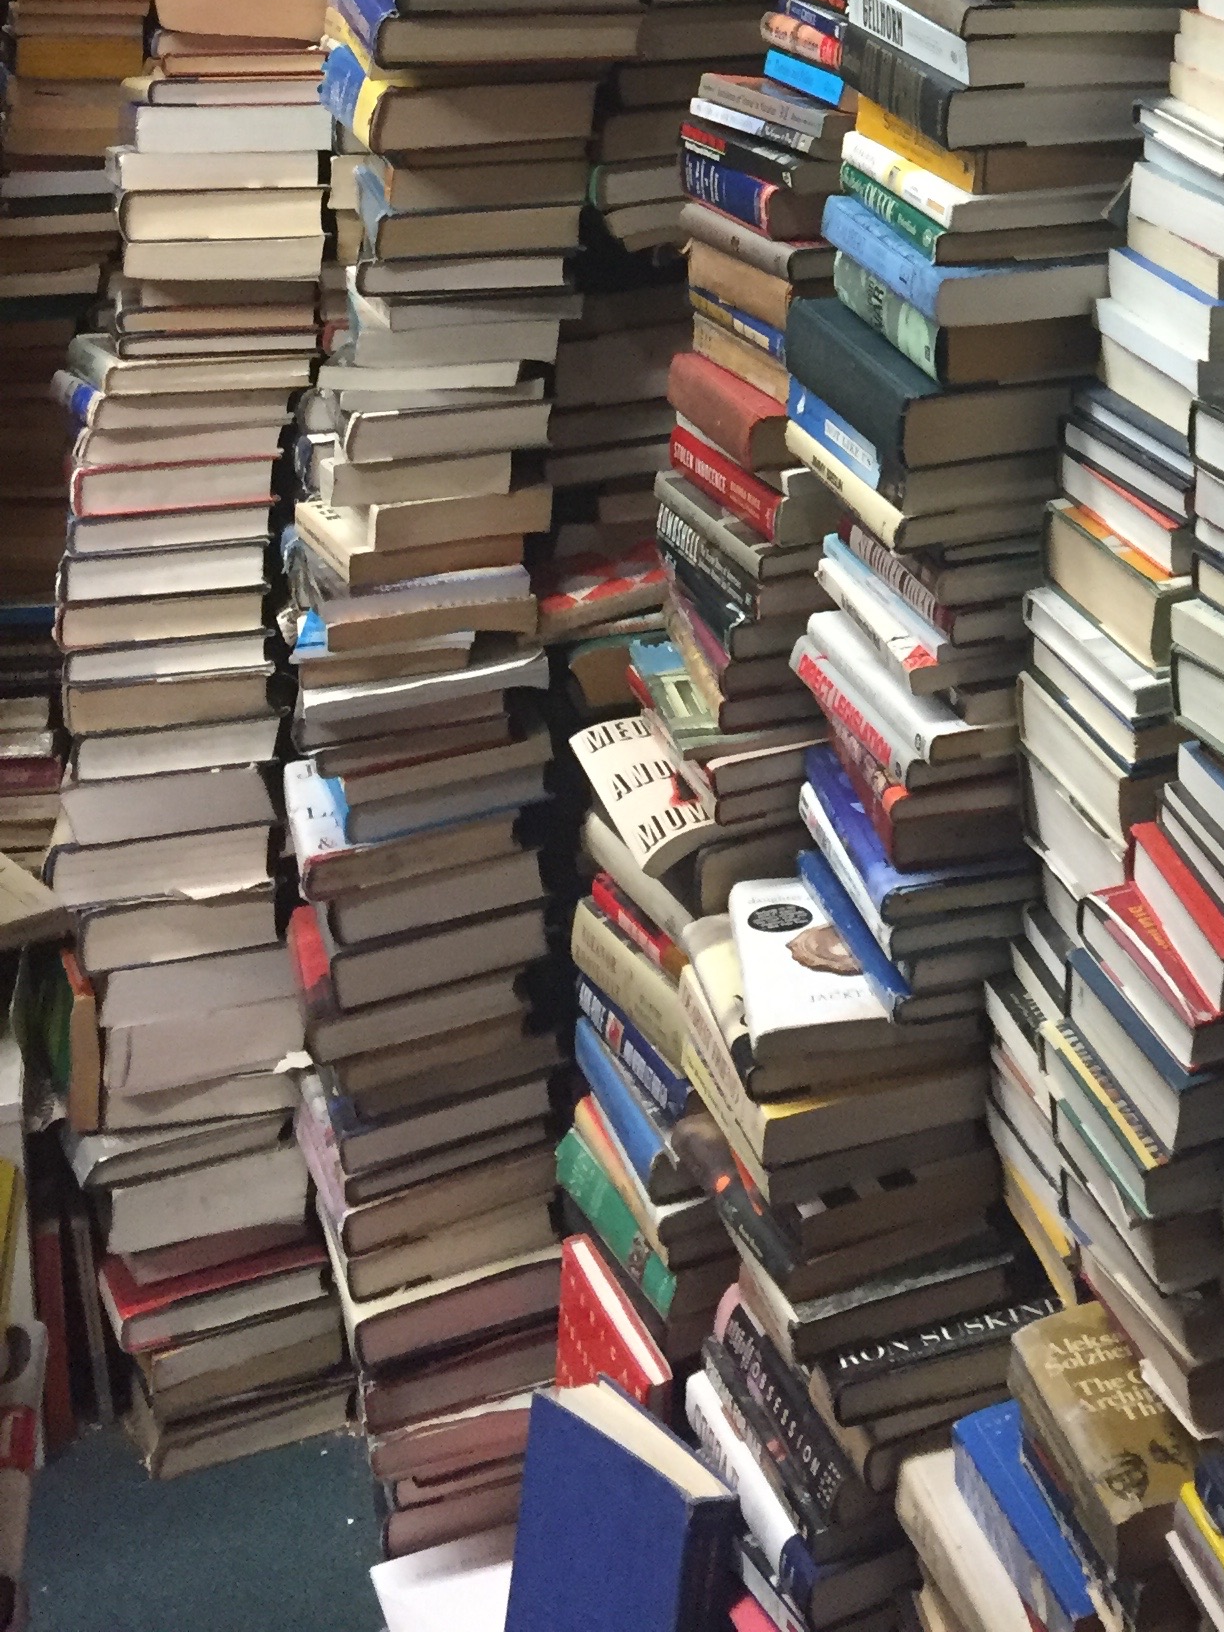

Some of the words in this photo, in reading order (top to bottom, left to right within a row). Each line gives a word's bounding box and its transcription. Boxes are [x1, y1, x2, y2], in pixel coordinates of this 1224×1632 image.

[672, 440, 695, 470] STOLEN
[695, 458, 727, 495] INNOCENCE
[837, 1344, 910, 1370] RON
[1074, 1376, 1125, 1397] The
[751, 1360, 821, 1477] OBSESSION
